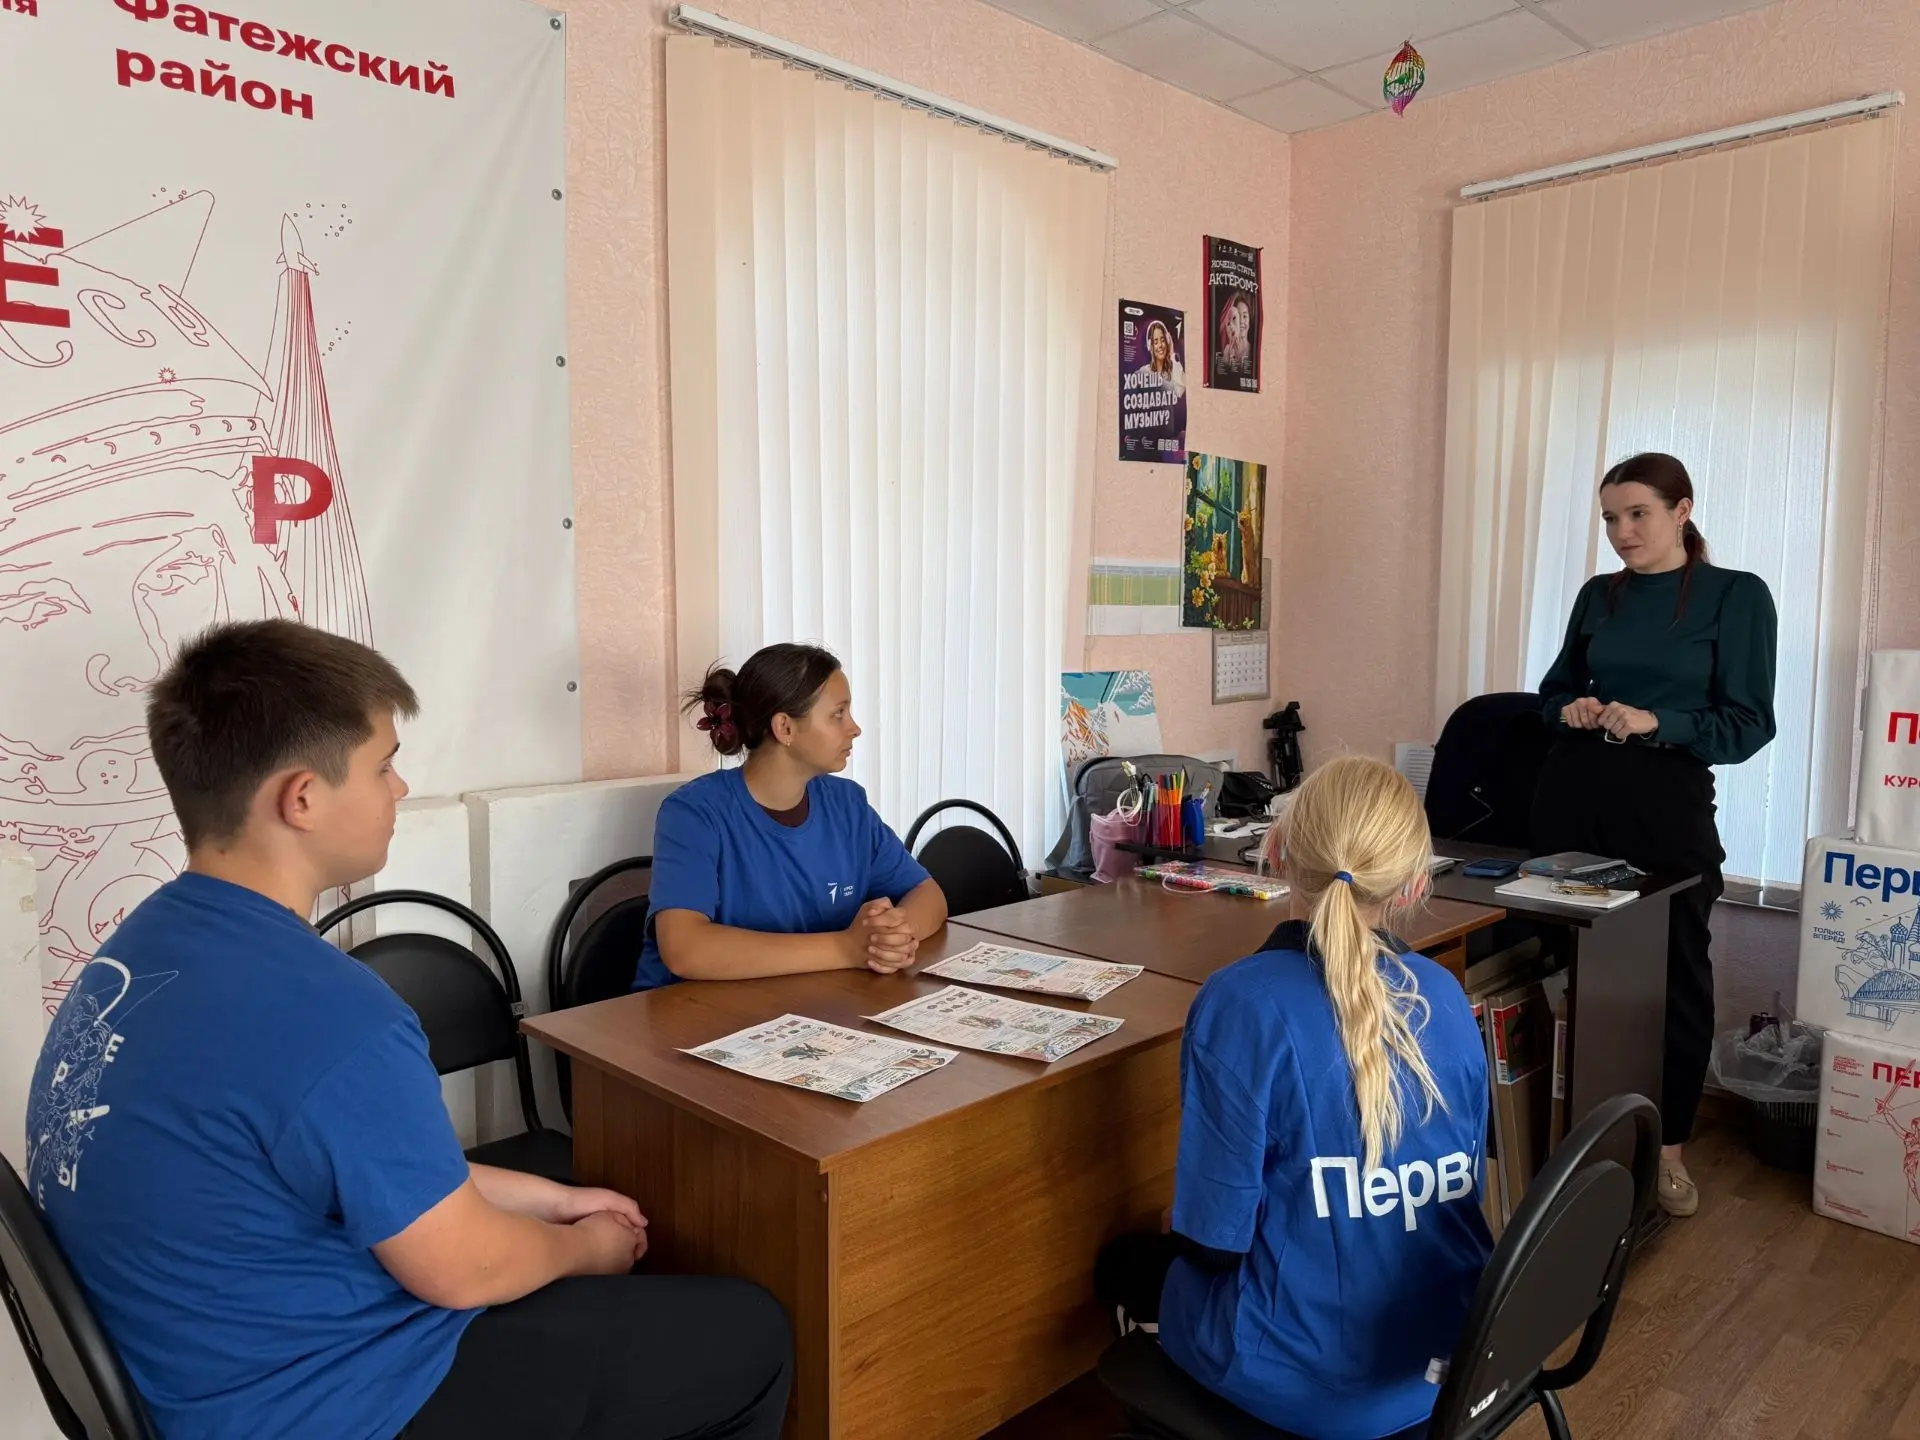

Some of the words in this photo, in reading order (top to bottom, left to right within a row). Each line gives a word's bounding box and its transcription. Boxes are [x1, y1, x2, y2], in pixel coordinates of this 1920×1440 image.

[112, 0, 455, 99] Фатежский
[116, 48, 314, 120] район
[1208, 272, 1259, 293] АКТЁРОМ?
[1123, 372, 1163, 390] ХОЧЕШЬ
[1123, 390, 1178, 410] СОЗДАВАТЬ
[1124, 409, 1170, 430] МУЗЫКУ?
[1887, 711, 1920, 745] П
[1884, 774, 1920, 789] КУР
[1813, 926, 1845, 937] ТОЛЬКО
